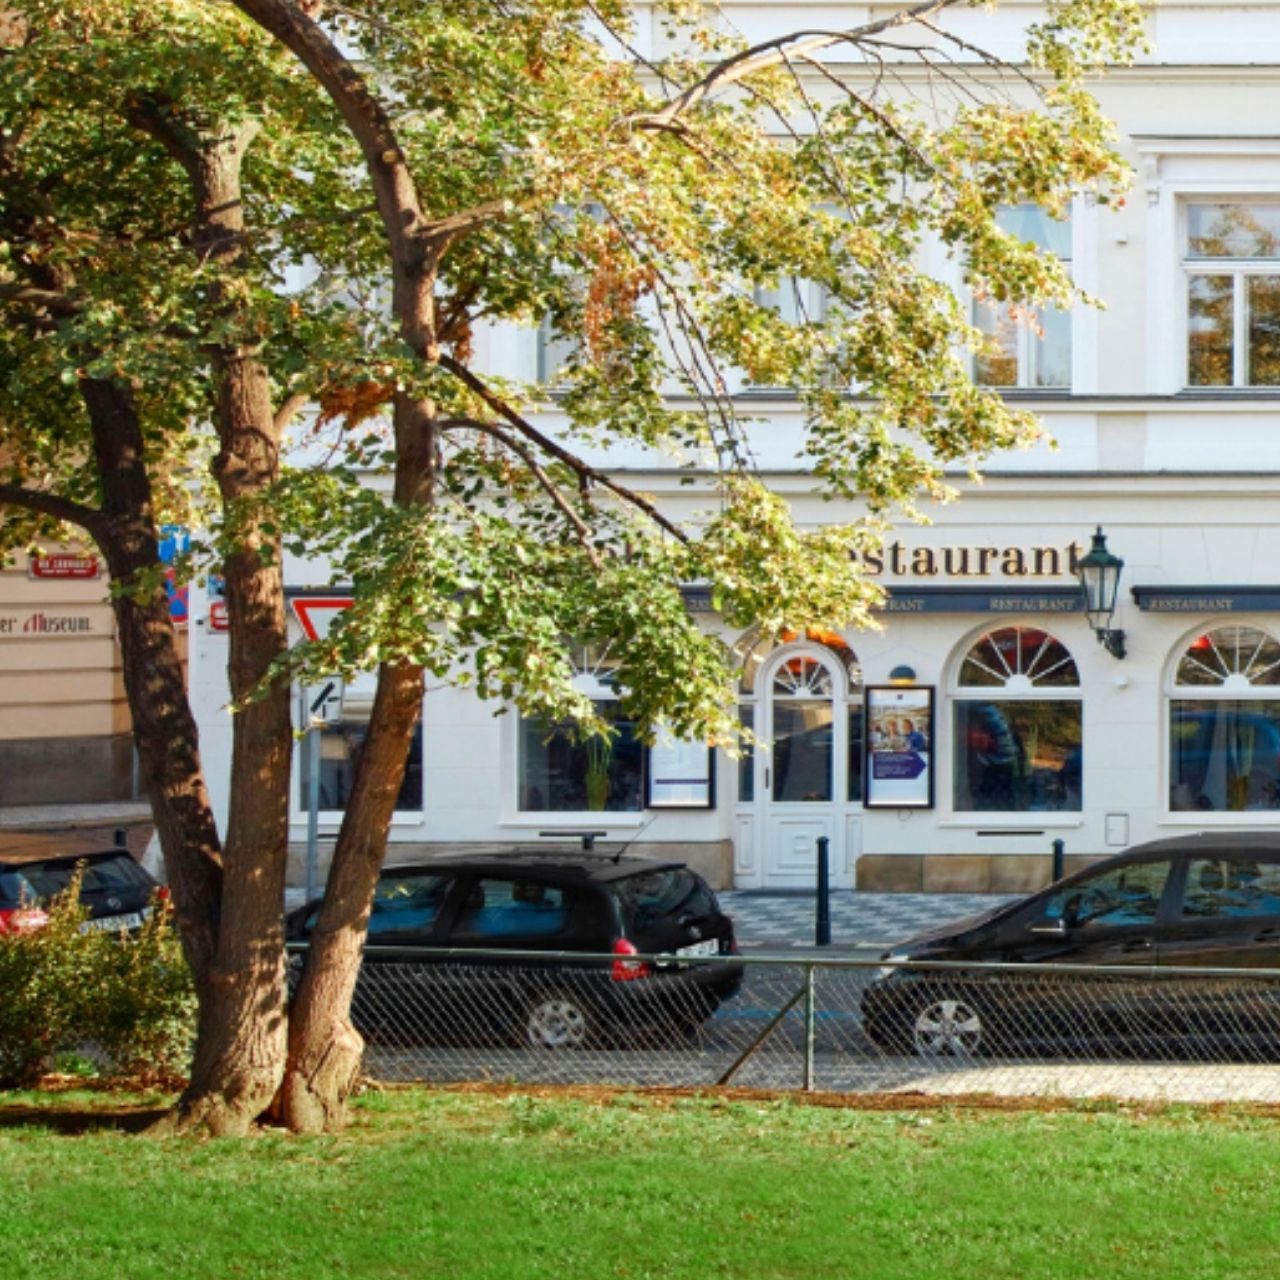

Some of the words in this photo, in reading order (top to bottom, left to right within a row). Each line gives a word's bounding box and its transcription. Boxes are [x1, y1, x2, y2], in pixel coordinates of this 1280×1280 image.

[848, 540, 1084, 577] staurant
[989, 597, 1075, 611] RESTAURANT
[1149, 598, 1234, 611] RESTAURANT
